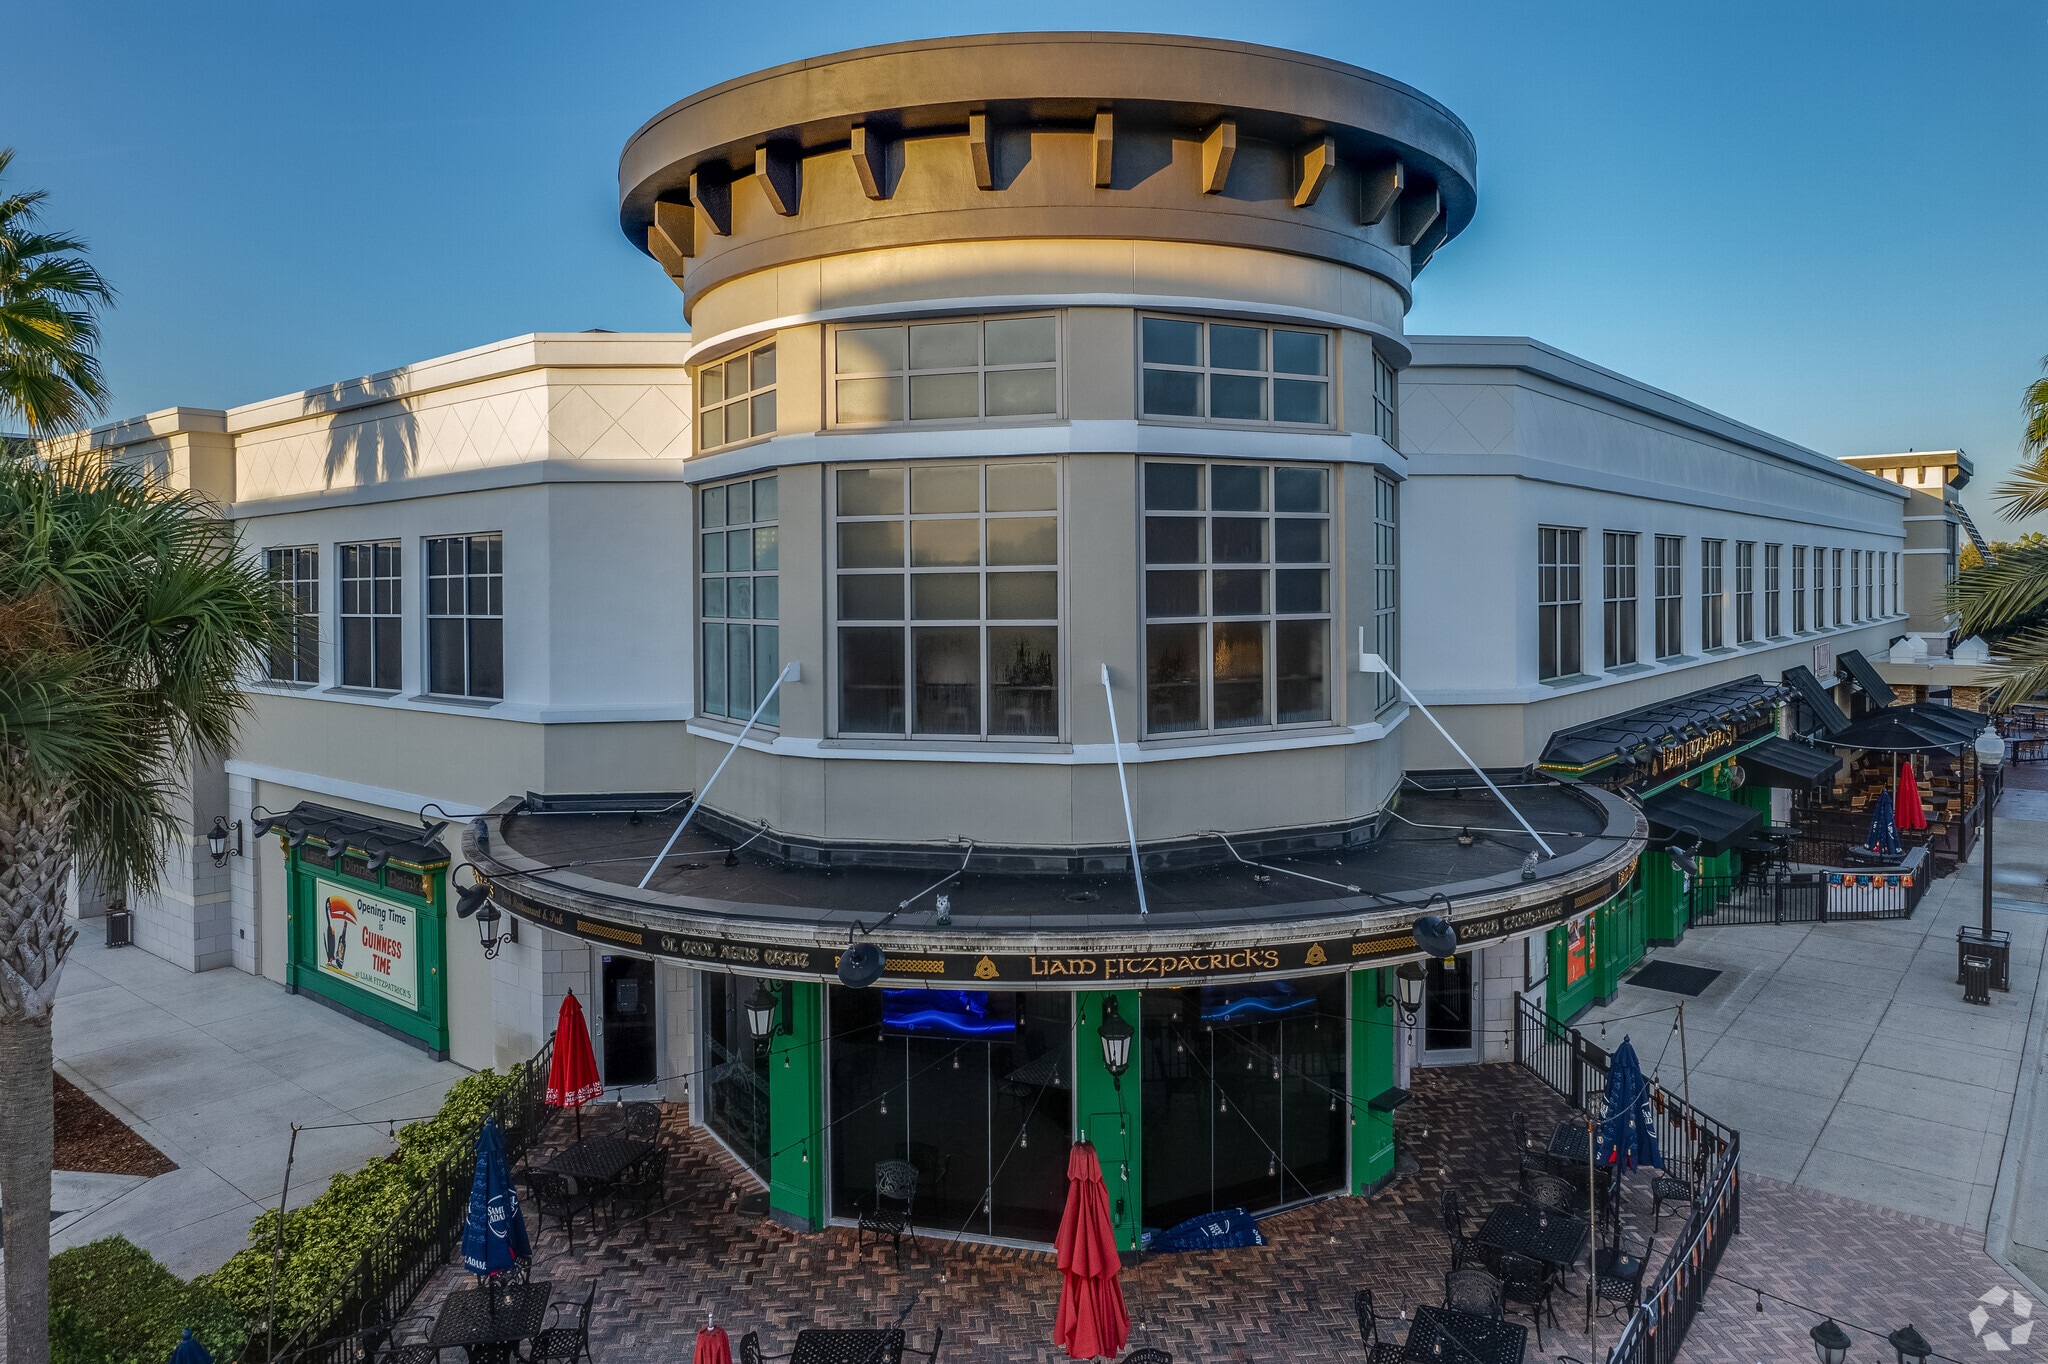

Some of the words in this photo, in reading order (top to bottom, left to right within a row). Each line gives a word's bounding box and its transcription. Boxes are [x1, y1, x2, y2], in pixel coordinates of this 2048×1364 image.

[357, 898, 387, 922] Opening
[388, 908, 407, 926] Time
[378, 920, 384, 931] is
[361, 925, 402, 960] GUINNESS
[372, 953, 392, 976] TIME
[1029, 956, 1097, 976] LIAM
[1104, 948, 1280, 980] FITZPATRICK'S
[360, 972, 373, 984] LIAM
